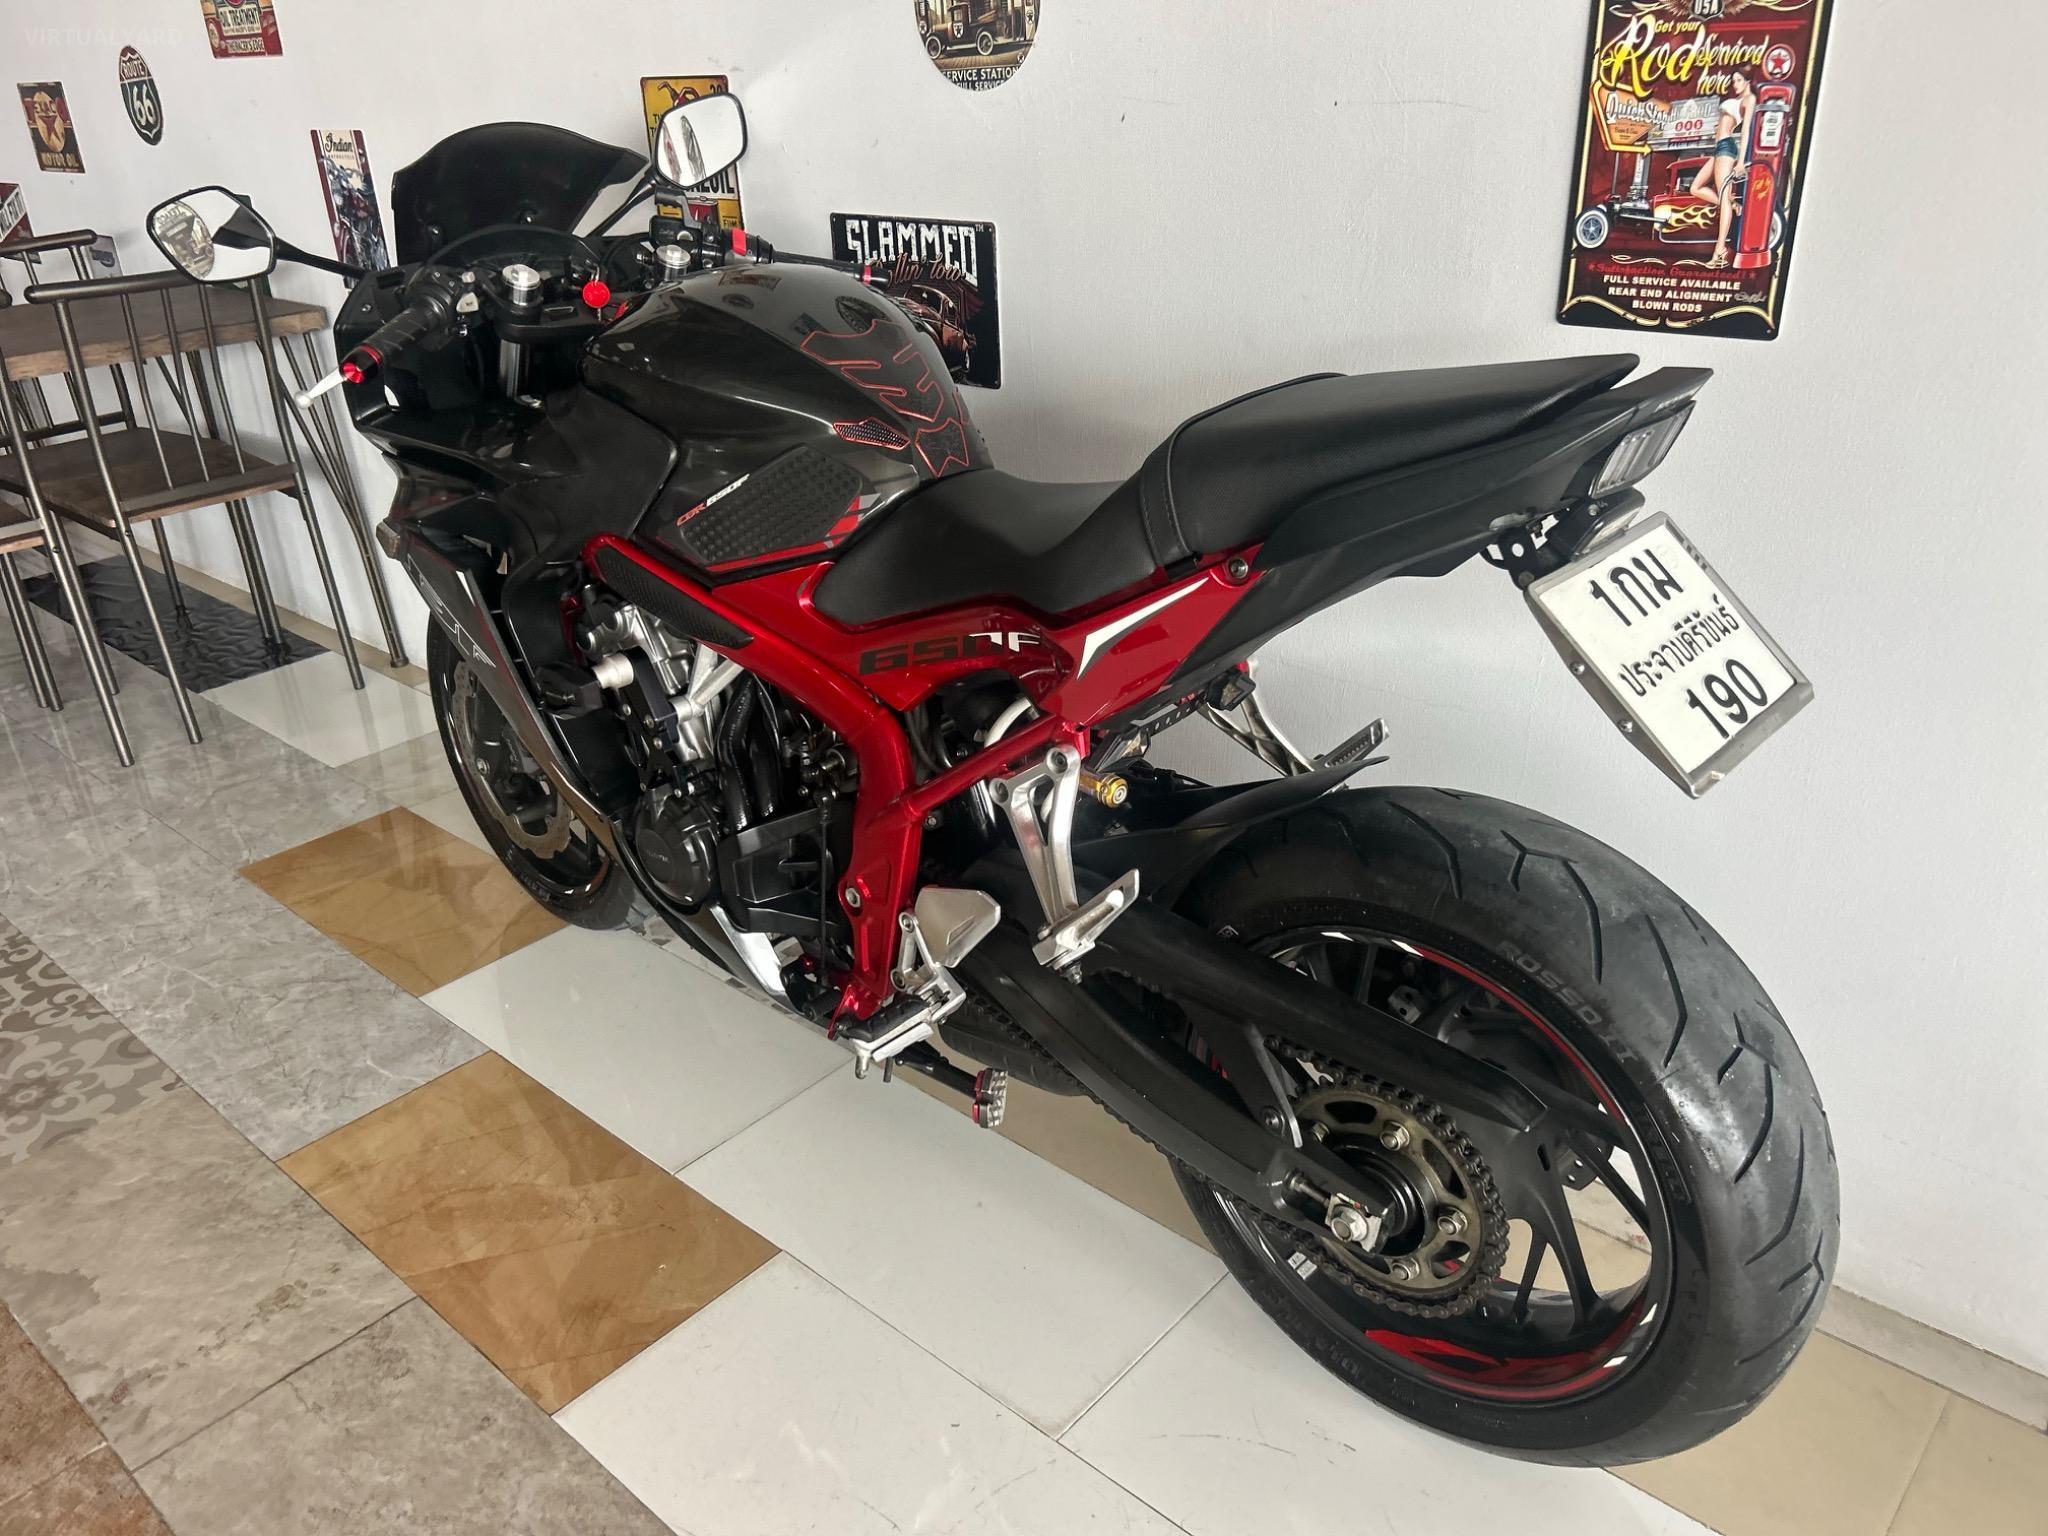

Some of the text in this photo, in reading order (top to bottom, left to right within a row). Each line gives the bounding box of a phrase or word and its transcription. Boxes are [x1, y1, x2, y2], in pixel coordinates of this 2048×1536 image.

[229, 8, 260, 26] TREATMENT
[1655, 20, 1699, 36] Get your
[1601, 14, 1705, 97] Rod
[1696, 33, 1769, 67] Serviced
[122, 61, 146, 79] ROUTE
[1697, 68, 1733, 95] here
[132, 85, 156, 125] 66
[325, 133, 353, 153] Indian
[42, 153, 66, 167] MOTOR
[846, 219, 978, 287] SLAMMED
[1603, 275, 1741, 291] FULL SERVICE AVAILABLE
[1608, 287, 1637, 297] REAR
[1640, 289, 1663, 298] END
[1665, 291, 1732, 303] ALIGNMENT
[1632, 301, 1703, 313] BLOWN RODS
[1590, 549, 1684, 627] 1กม
[1620, 594, 1740, 697] ประจวบคีรีขันธ์
[1687, 659, 1768, 739] 190
[1499, 941, 1602, 1025] ROSSO
